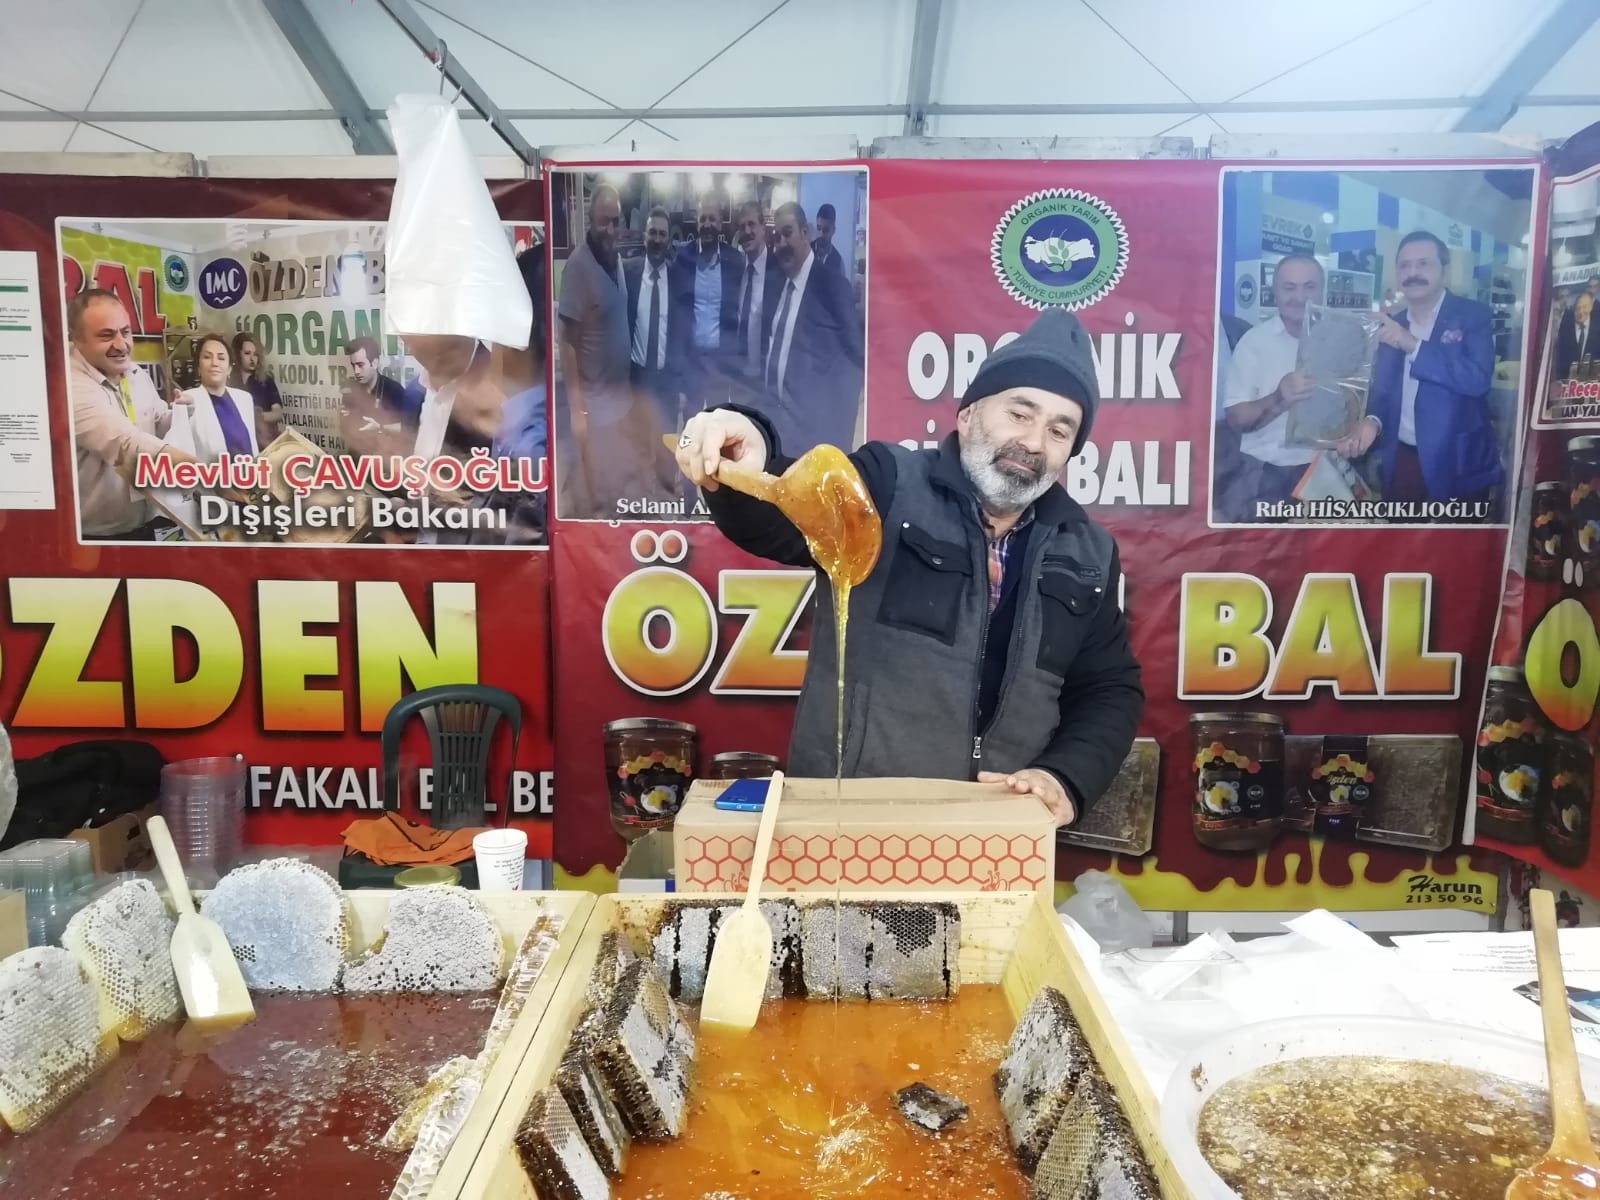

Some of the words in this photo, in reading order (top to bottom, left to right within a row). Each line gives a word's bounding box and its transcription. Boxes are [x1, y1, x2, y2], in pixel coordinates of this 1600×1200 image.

[205, 267, 241, 295] IMC
[134, 452, 272, 489] Mevlüt
[283, 447, 548, 499] ÇAVUŞOĞLU
[1066, 440, 1191, 505] BALI
[201, 494, 356, 535] Dışişleri
[371, 497, 507, 529] Bakanı
[616, 498, 685, 514] Selami
[1309, 496, 1491, 519] HİSARCIKLIOĞLU
[1177, 572, 1463, 700] BAL
[0, 576, 479, 733] ZDEN
[1405, 895, 1433, 904] 213
[1438, 894, 1457, 903] 50
[1462, 896, 1484, 905] 96
[1407, 875, 1482, 895] Harun
